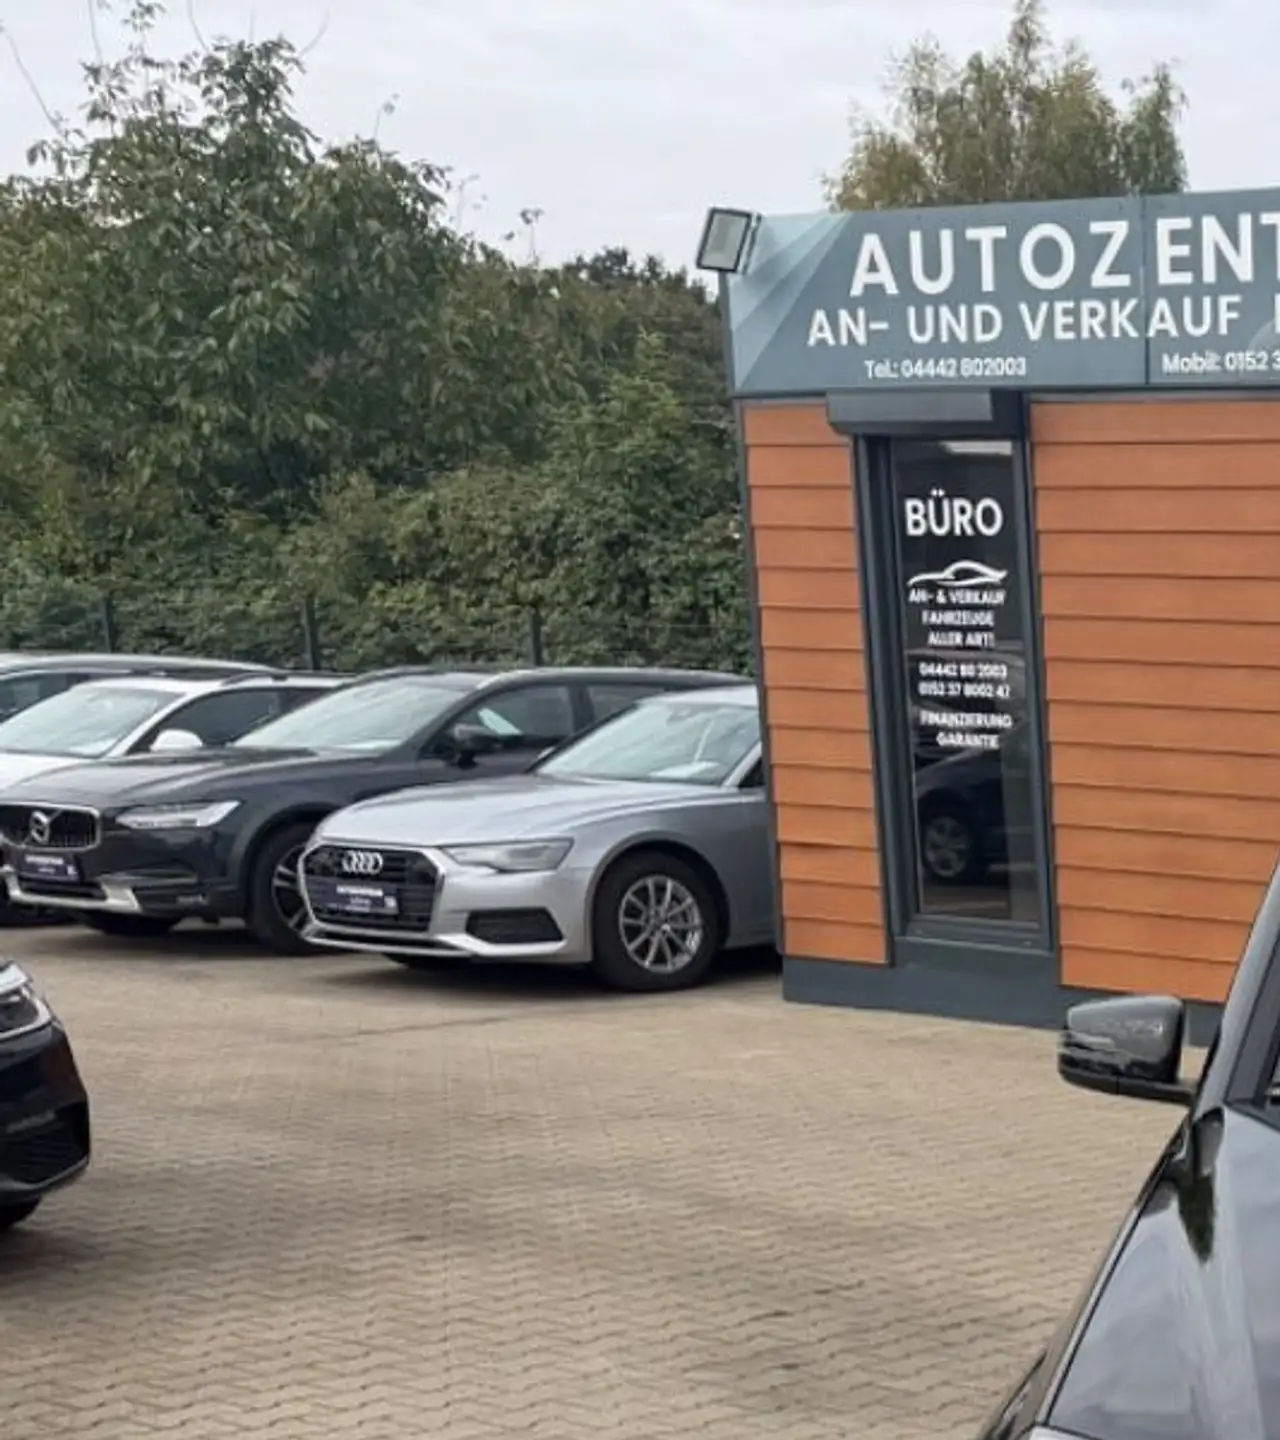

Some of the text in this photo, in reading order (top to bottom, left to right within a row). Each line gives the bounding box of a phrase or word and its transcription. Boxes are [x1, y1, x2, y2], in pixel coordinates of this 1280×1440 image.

[808, 306, 889, 346] AN-
[906, 302, 1003, 344] UND
[1019, 295, 1242, 342] VERKAUF
[1225, 350, 1268, 371] 0152
[905, 487, 1003, 537] BÜRO
